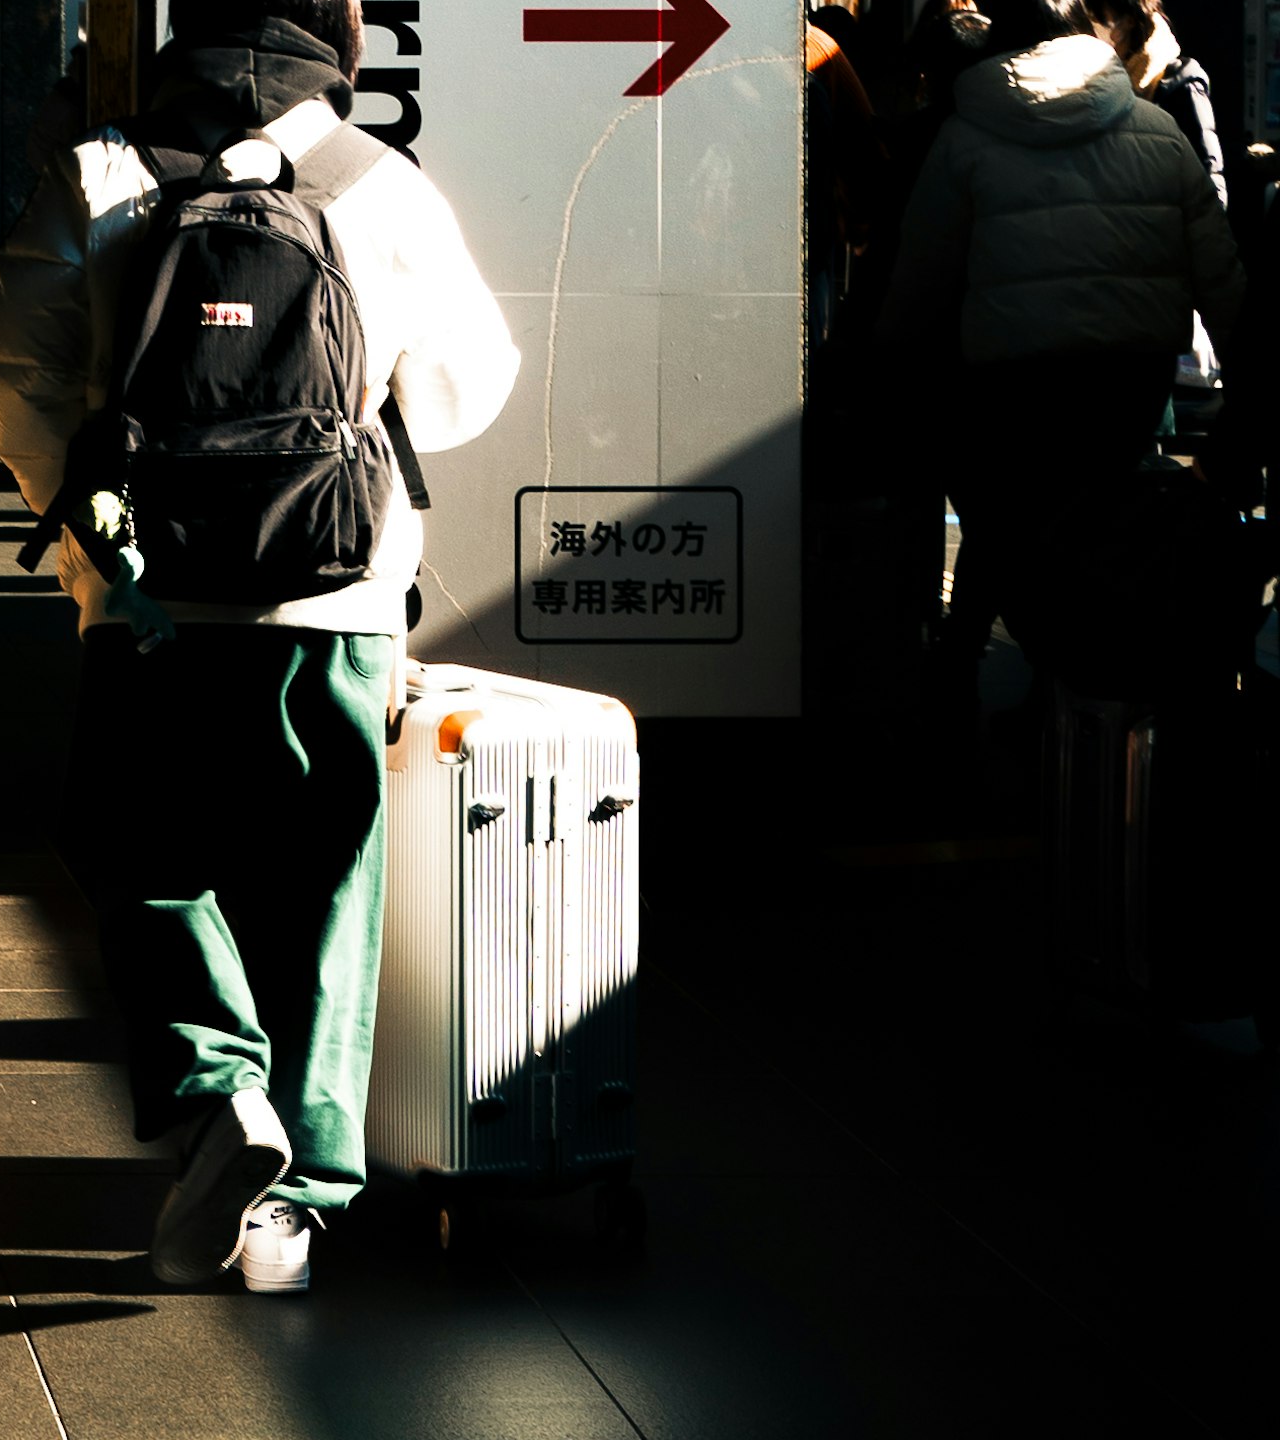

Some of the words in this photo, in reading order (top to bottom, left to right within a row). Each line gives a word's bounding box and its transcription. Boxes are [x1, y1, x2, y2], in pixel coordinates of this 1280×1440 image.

[550, 521, 708, 558] 海外の方
[532, 579, 726, 615] 専用案内所
